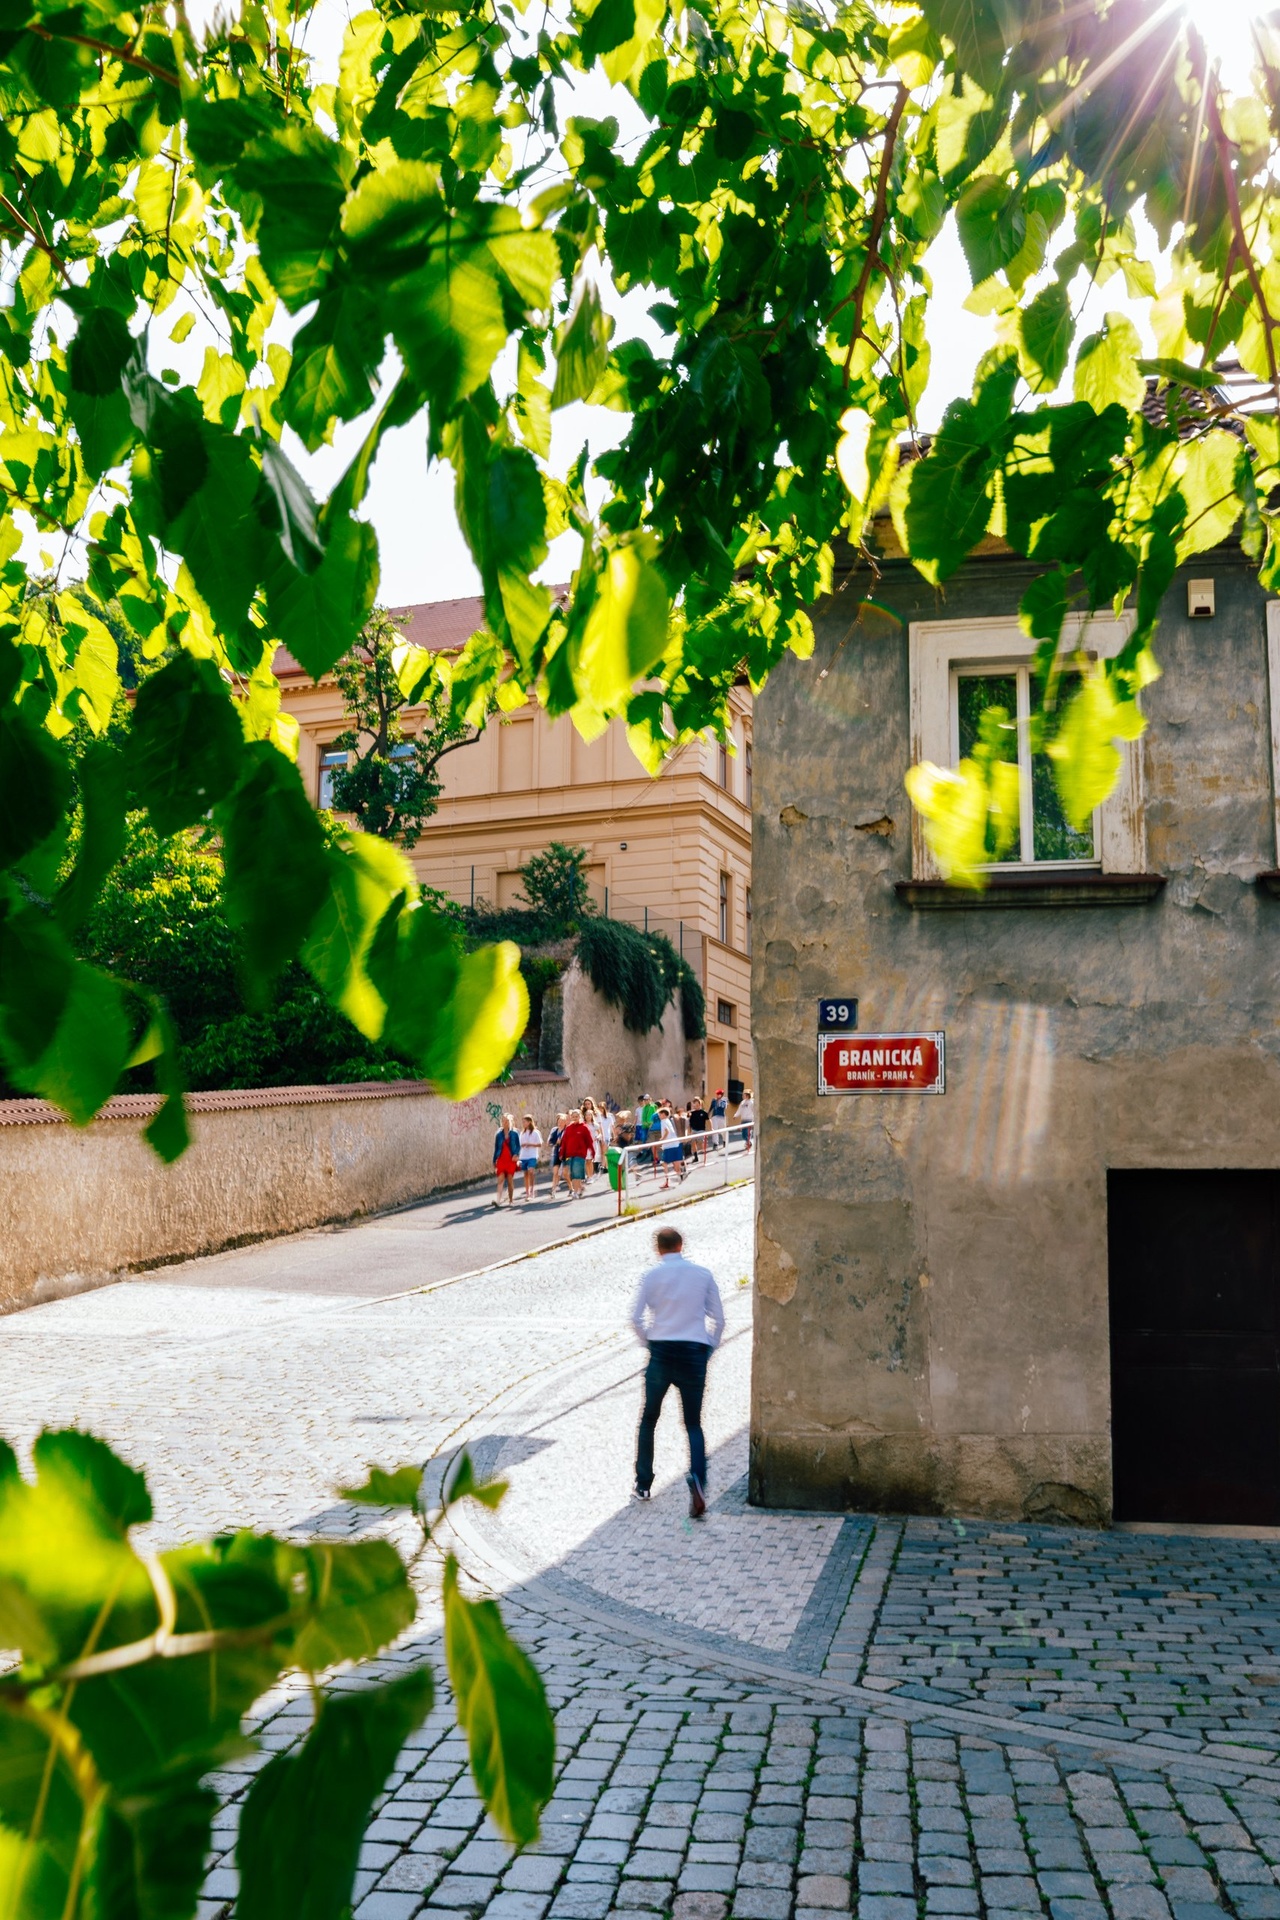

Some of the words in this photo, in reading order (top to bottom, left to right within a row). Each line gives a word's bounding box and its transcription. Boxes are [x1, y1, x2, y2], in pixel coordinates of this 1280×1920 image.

[826, 1005, 849, 1022] 39
[838, 1046, 923, 1067] BRANICKÁ
[847, 1069, 875, 1081] BRANÍK
[882, 1071, 908, 1081] PRAHA
[909, 1070, 915, 1080] 4
